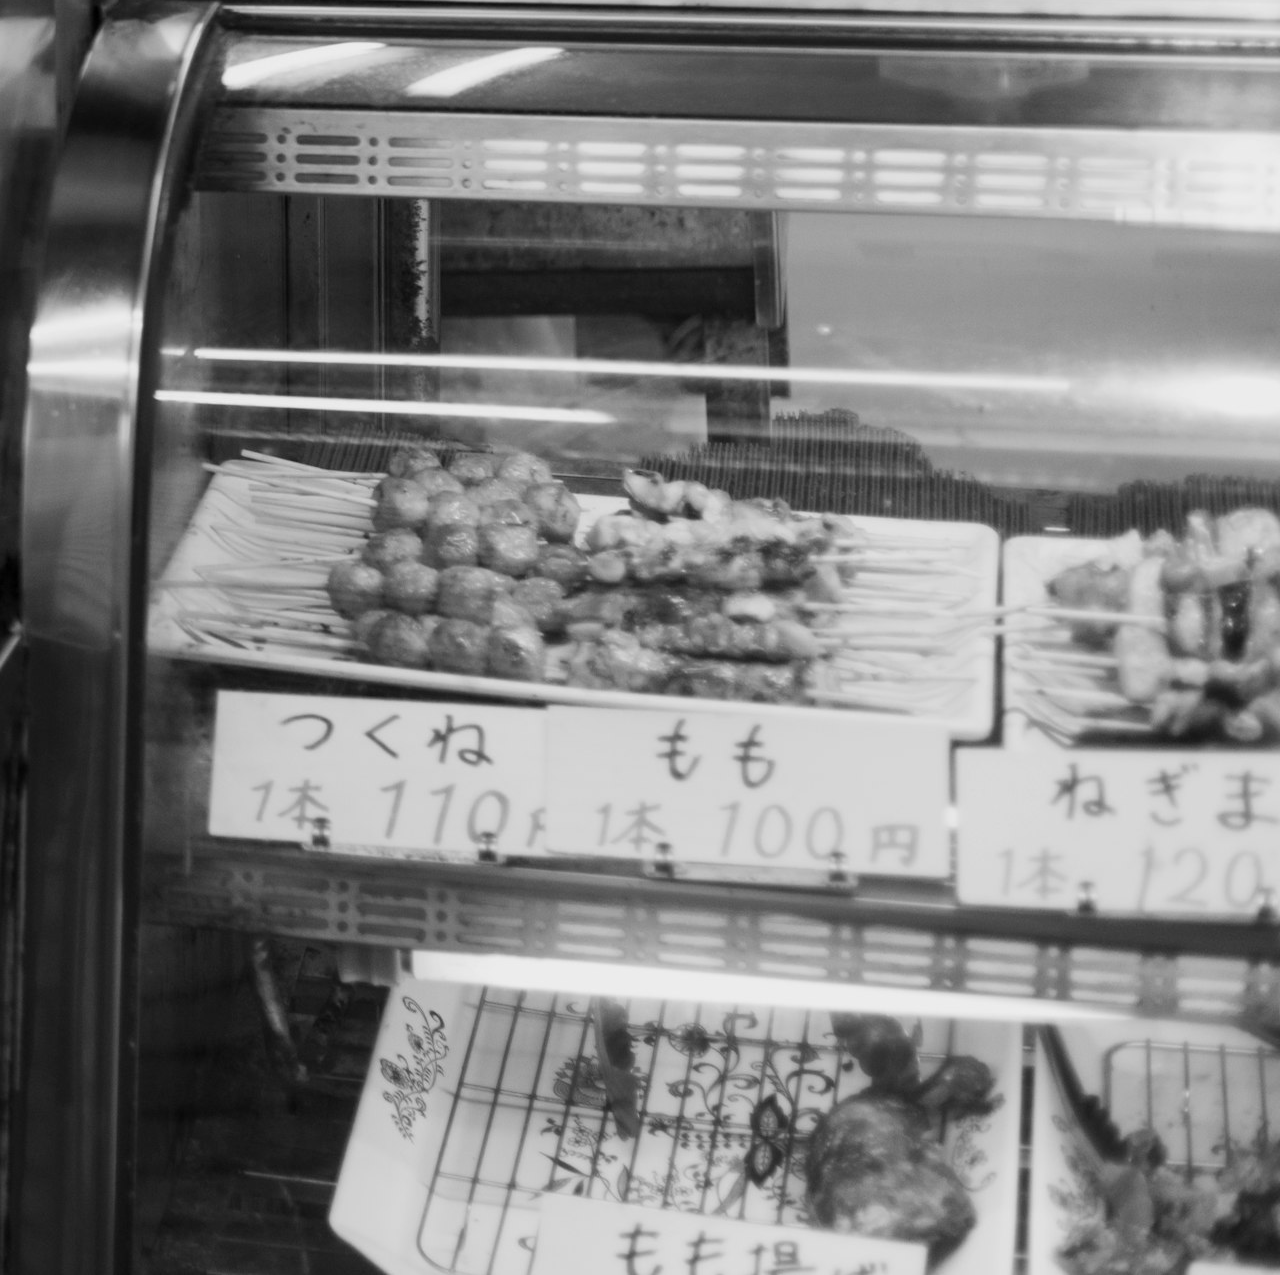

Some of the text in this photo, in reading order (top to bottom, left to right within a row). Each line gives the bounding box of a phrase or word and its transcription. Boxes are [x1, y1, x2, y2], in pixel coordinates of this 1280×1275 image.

[279, 711, 494, 767] つくね
[655, 719, 776, 789] もも
[250, 778, 331, 829] 1本
[1050, 761, 1279, 831] ねぎま
[596, 801, 666, 849] 1本
[997, 847, 1069, 900] 1本
